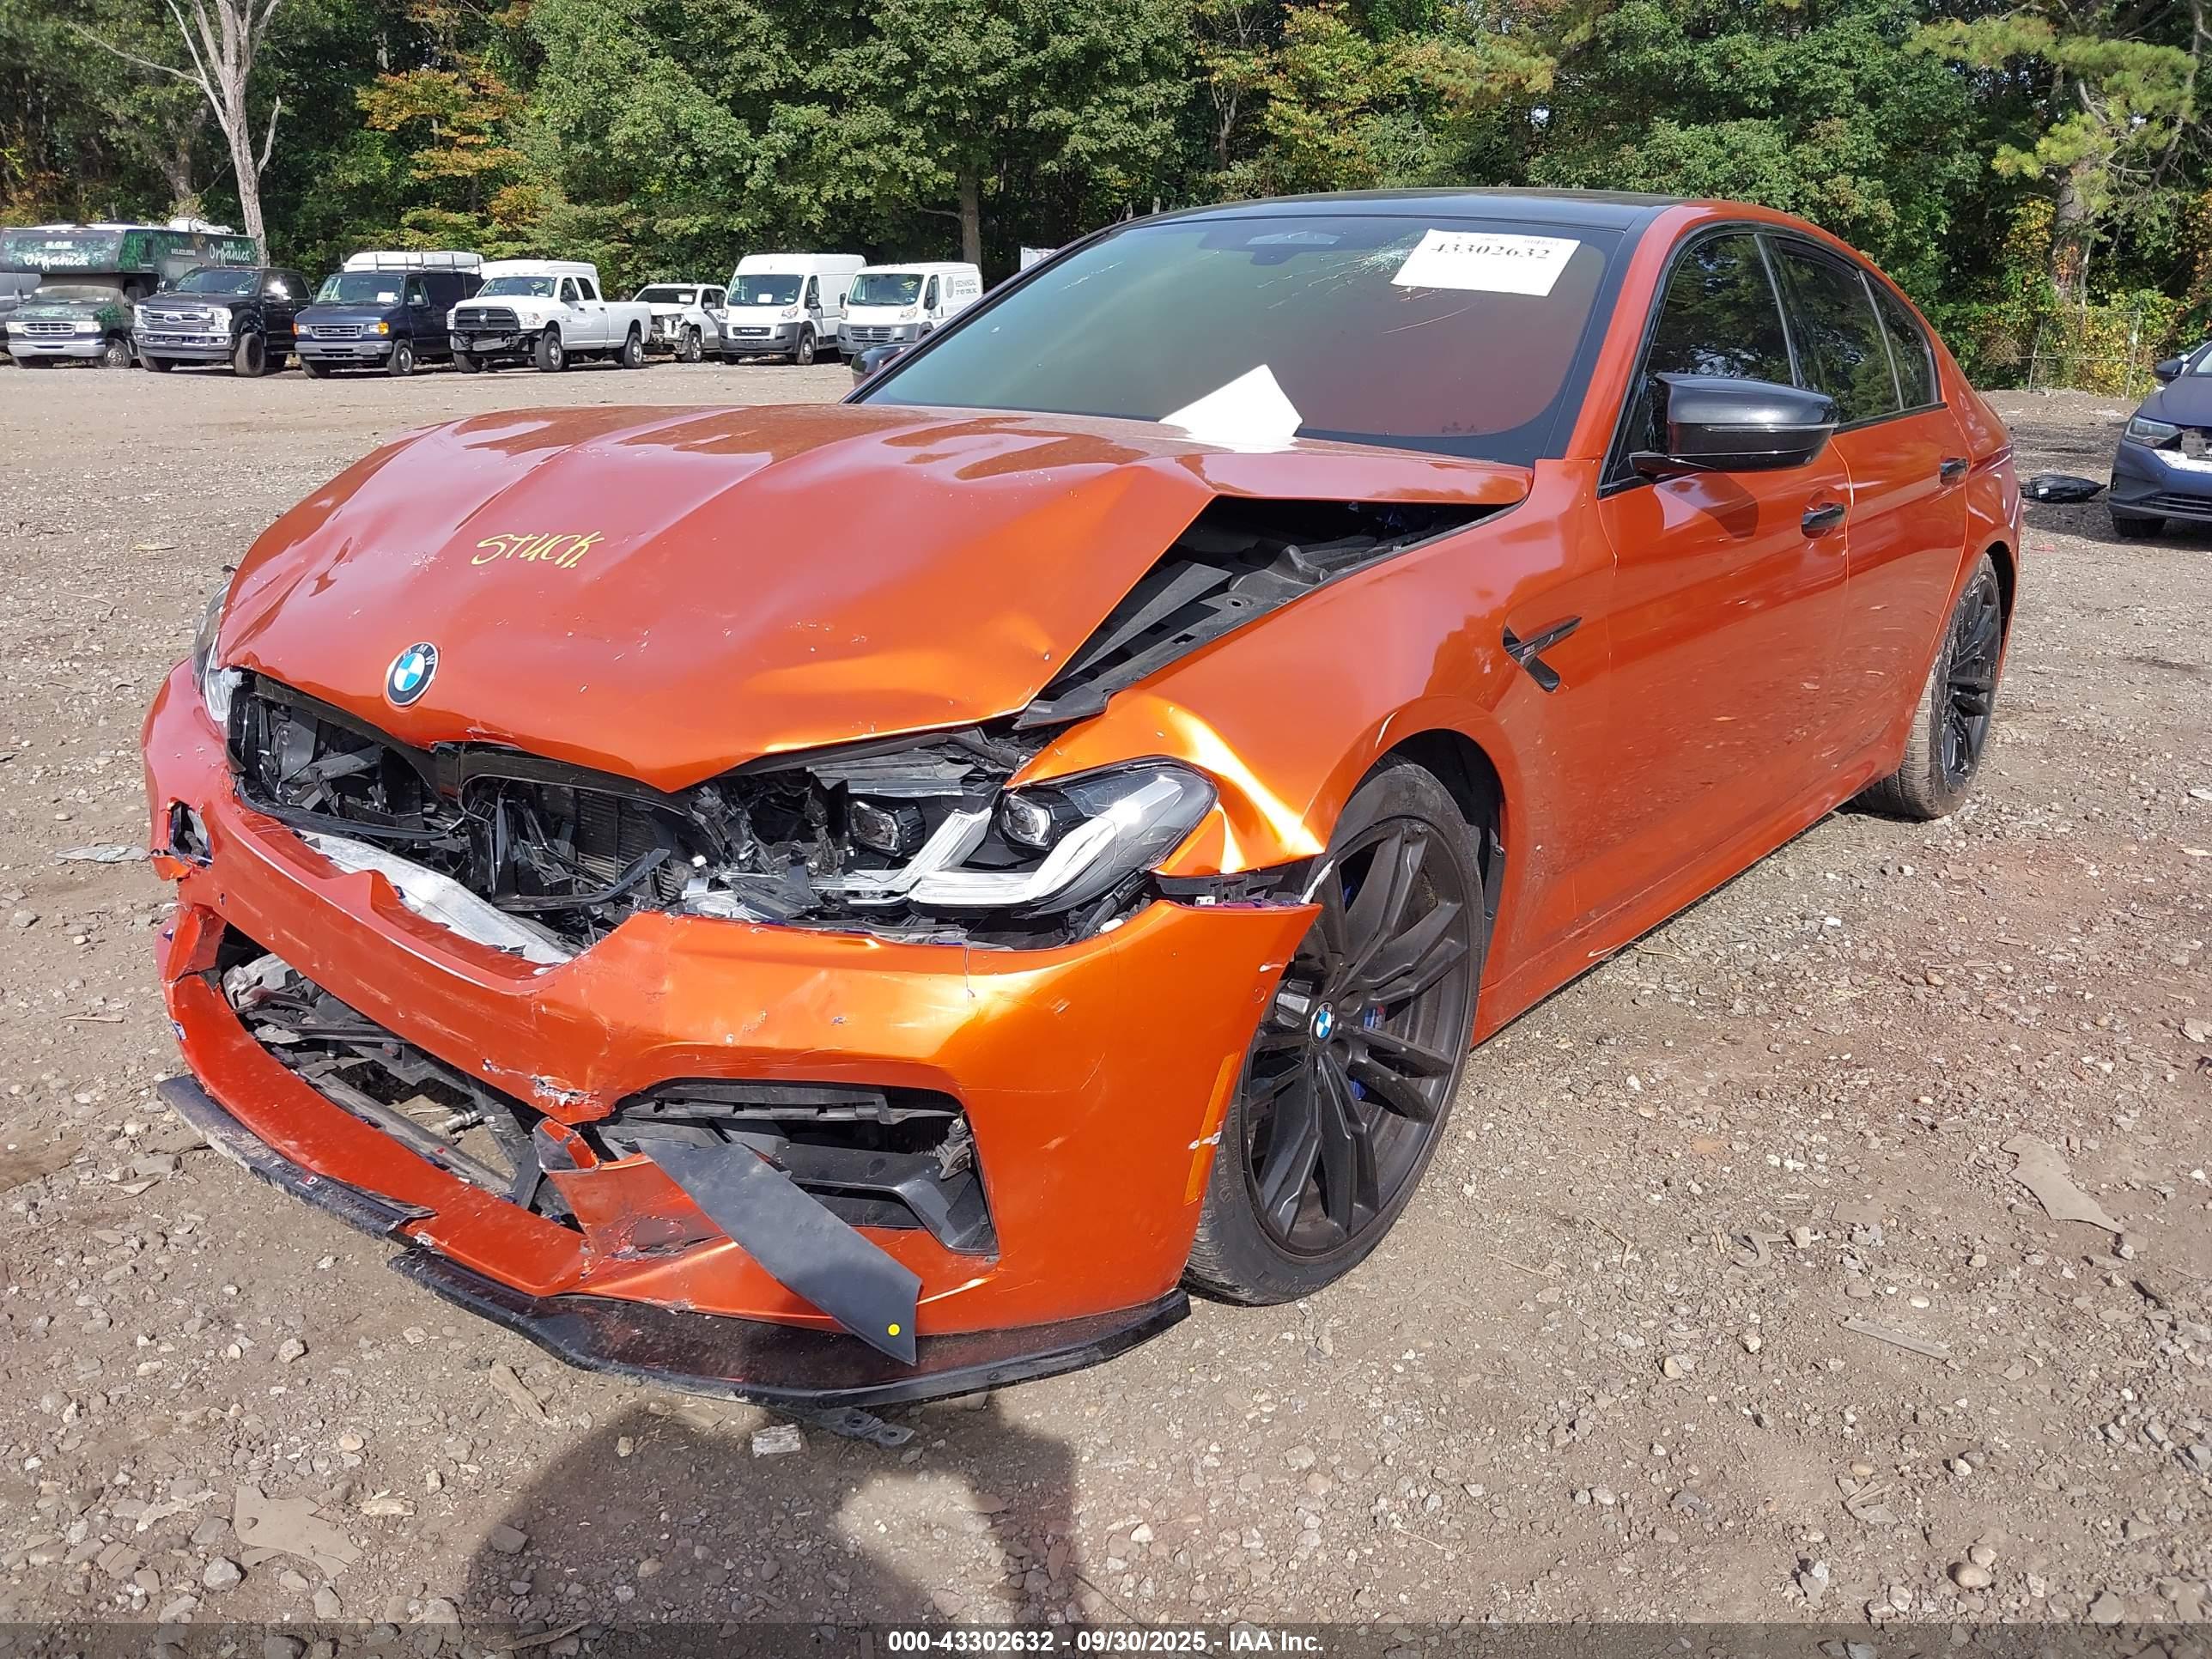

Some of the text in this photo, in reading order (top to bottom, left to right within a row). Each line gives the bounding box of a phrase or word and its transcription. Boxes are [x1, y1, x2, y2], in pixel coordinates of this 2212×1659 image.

[208, 243, 250, 266] Organics
[1430, 243, 1551, 259] 43302632
[23, 252, 89, 271] Organics
